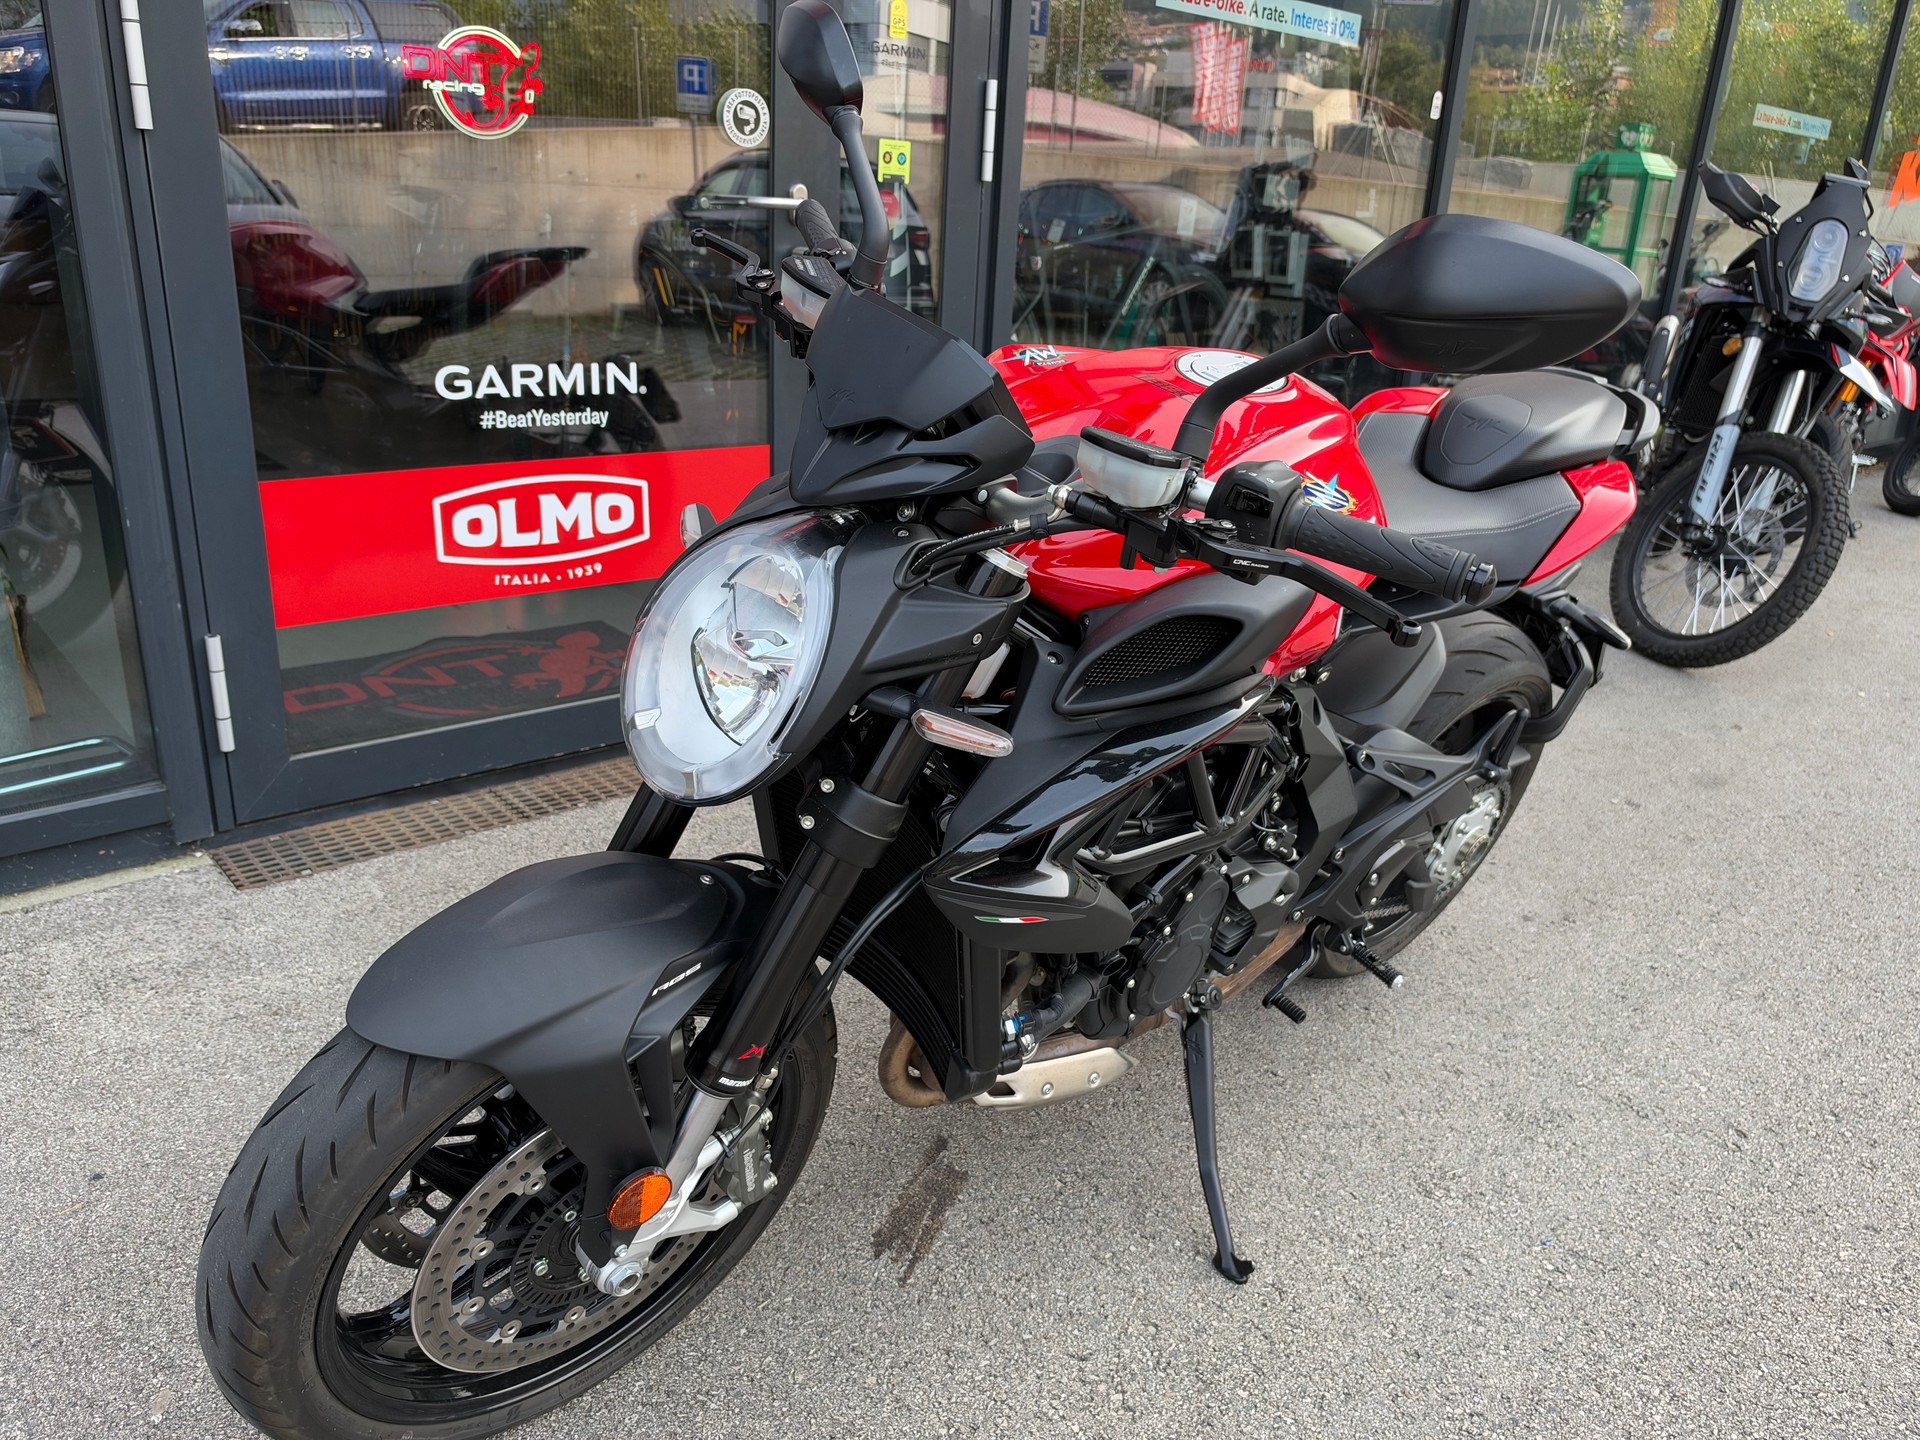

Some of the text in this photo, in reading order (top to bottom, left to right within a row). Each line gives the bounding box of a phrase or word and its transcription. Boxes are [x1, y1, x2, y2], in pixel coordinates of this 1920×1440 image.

[1249, 4, 1259, 18] A
[1261, 7, 1288, 24] rate.
[1290, 8, 1338, 35] Interessi
[1338, 19, 1356, 41] 0%
[402, 44, 499, 85] DNT
[870, 40, 927, 60] GARMIN
[422, 79, 485, 97] racing
[479, 407, 609, 429] #BeatYesterday
[451, 492, 635, 548] OLMO
[494, 562, 603, 586] ITALIA 1939
[282, 653, 508, 715] DNT
